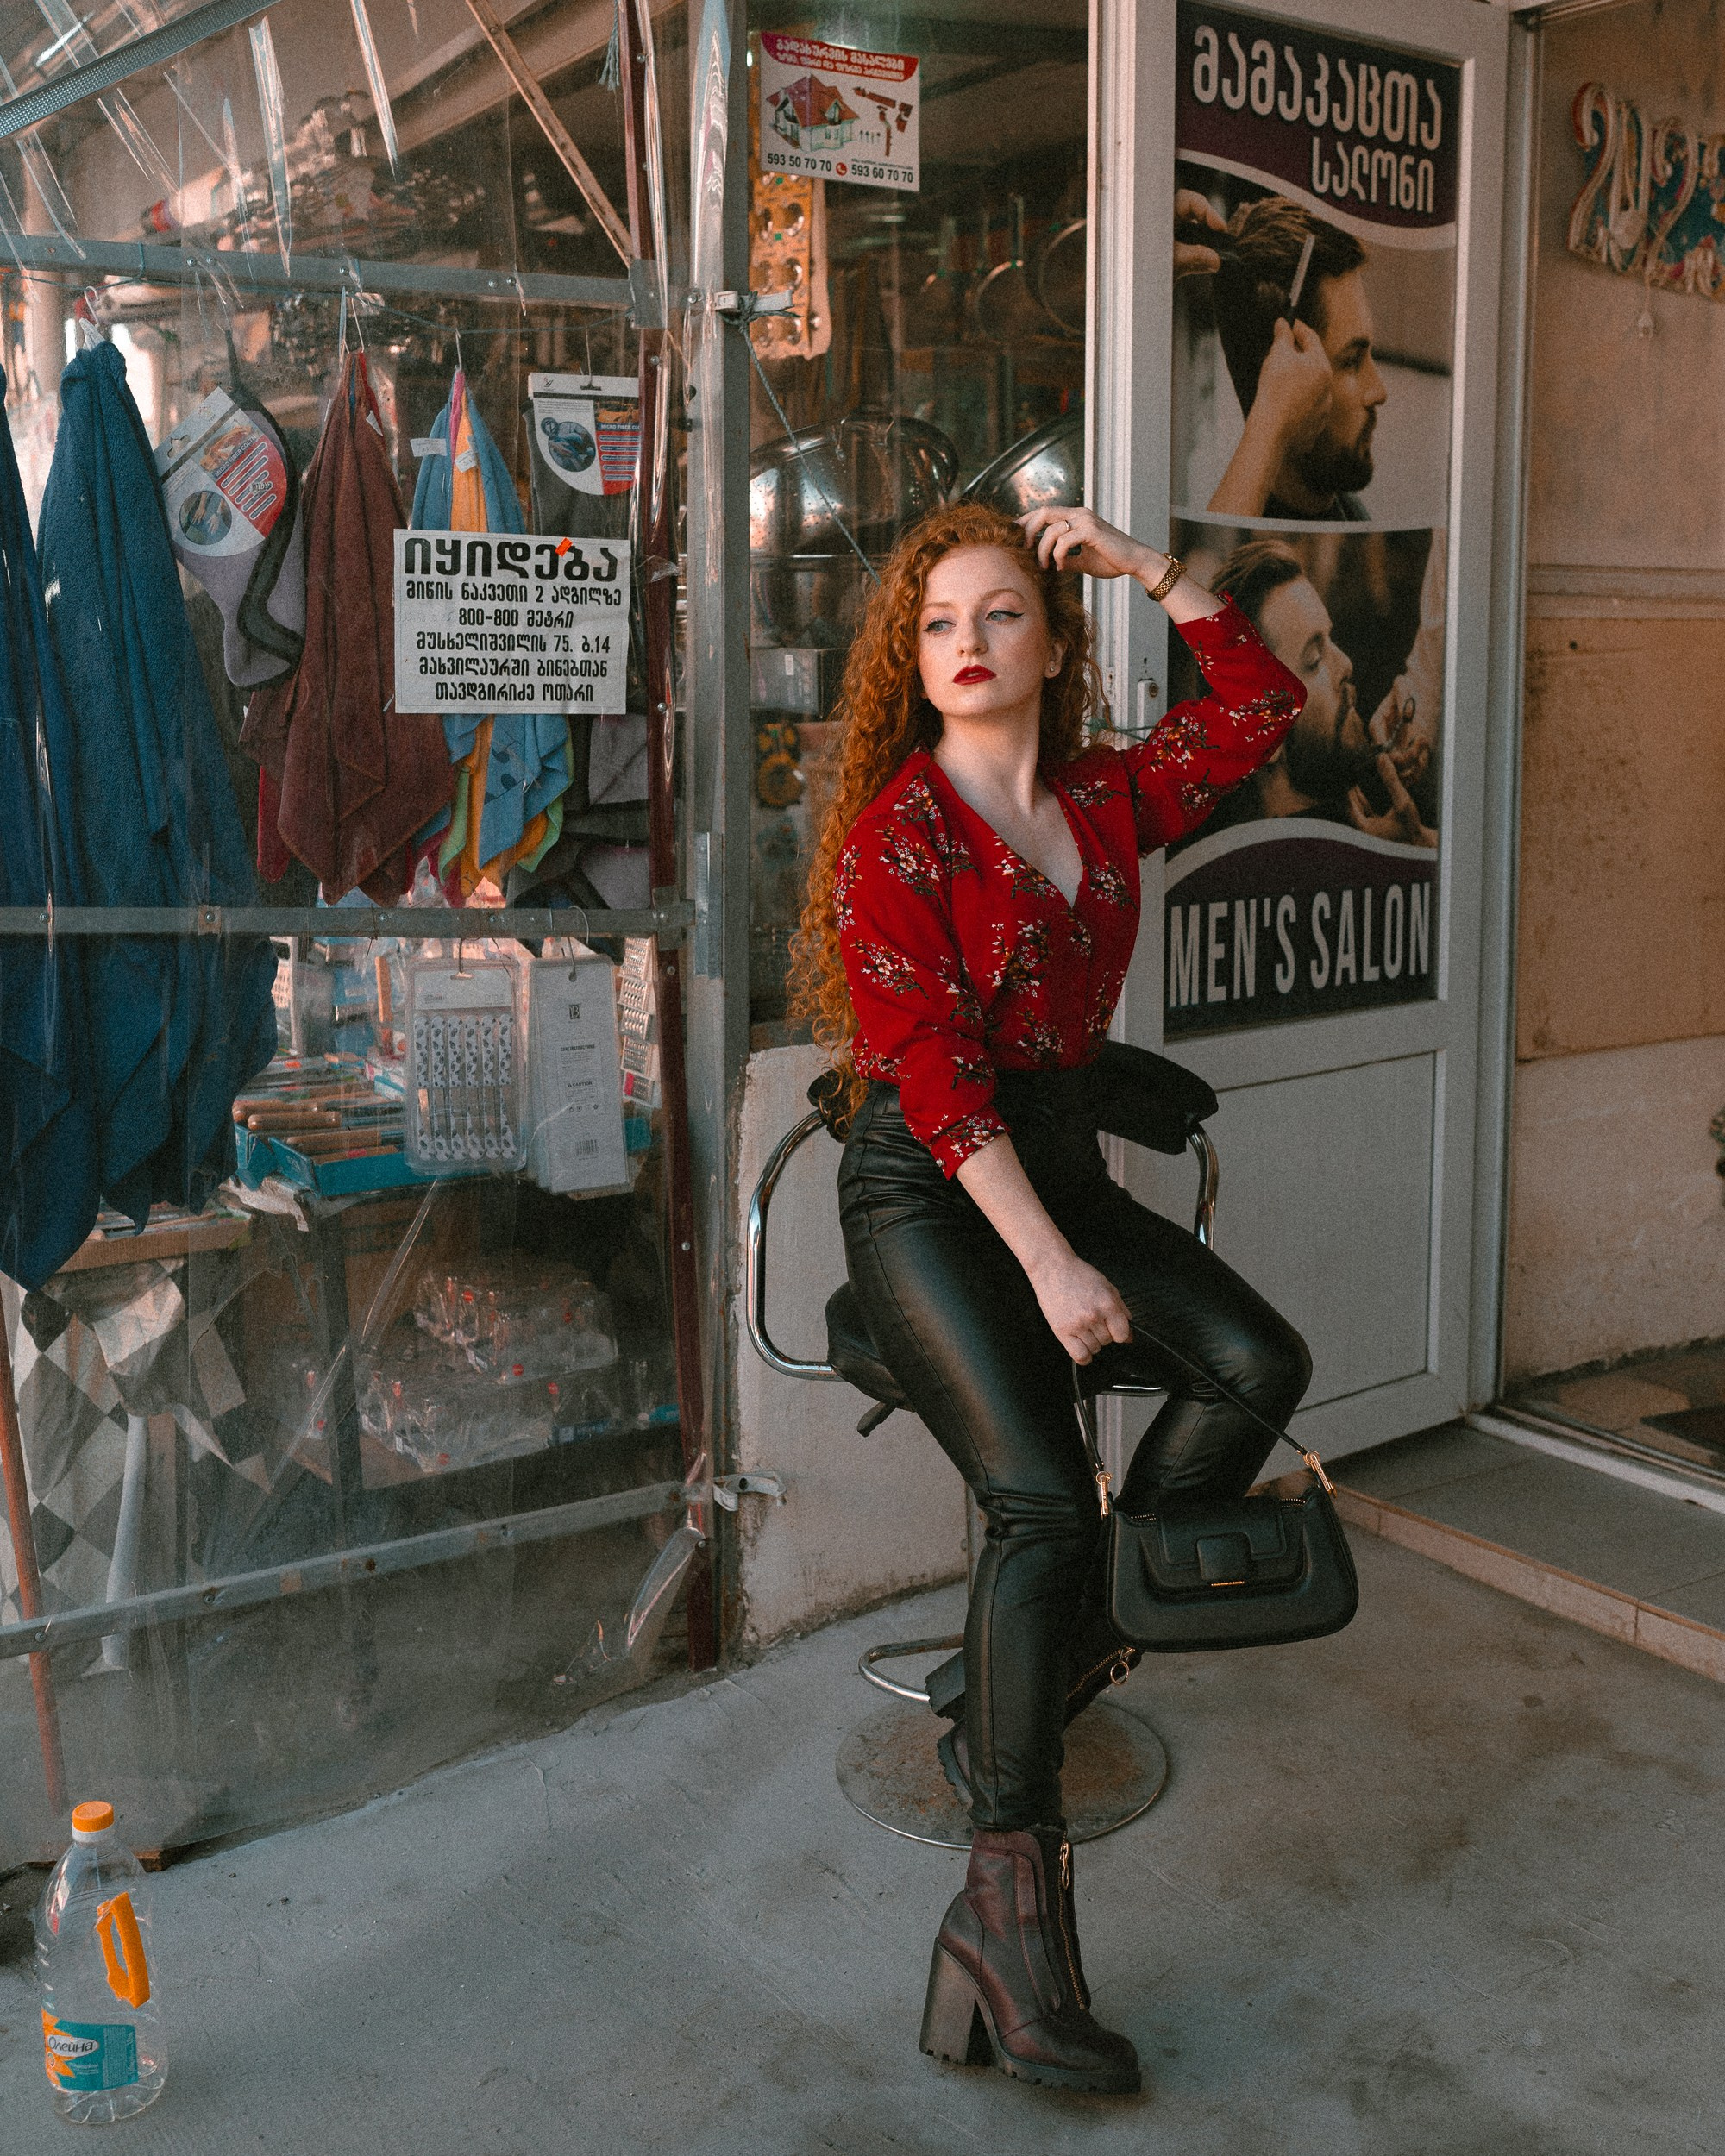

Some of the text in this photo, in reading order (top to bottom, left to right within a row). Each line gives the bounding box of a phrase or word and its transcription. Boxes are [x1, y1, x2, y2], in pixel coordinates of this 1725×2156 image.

[1192, 24, 1442, 152] მამაკაცთა
[767, 152, 786, 166] 593
[788, 156, 801, 167] 50
[804, 158, 817, 170] 70
[819, 160, 832, 172] 70
[851, 164, 870, 177] 593
[872, 166, 884, 179] 60
[888, 169, 899, 181] 70
[901, 171, 913, 183] 70
[405, 537, 618, 582] იყიდება
[406, 580, 621, 605] მიწის ნაკვეთი 2 ადგილზე
[459, 608, 519, 626] 800-800
[527, 610, 574, 628] მეტრი
[417, 631, 547, 652] მუსხელიშვილის
[554, 635, 573, 652] 75.
[537, 659, 607, 677] ბინებთან
[436, 682, 593, 702] თავდგირიძე ოთარი
[1169, 881, 1431, 1008] MEN'S SALON
[48, 2036, 94, 2053] Олейна
